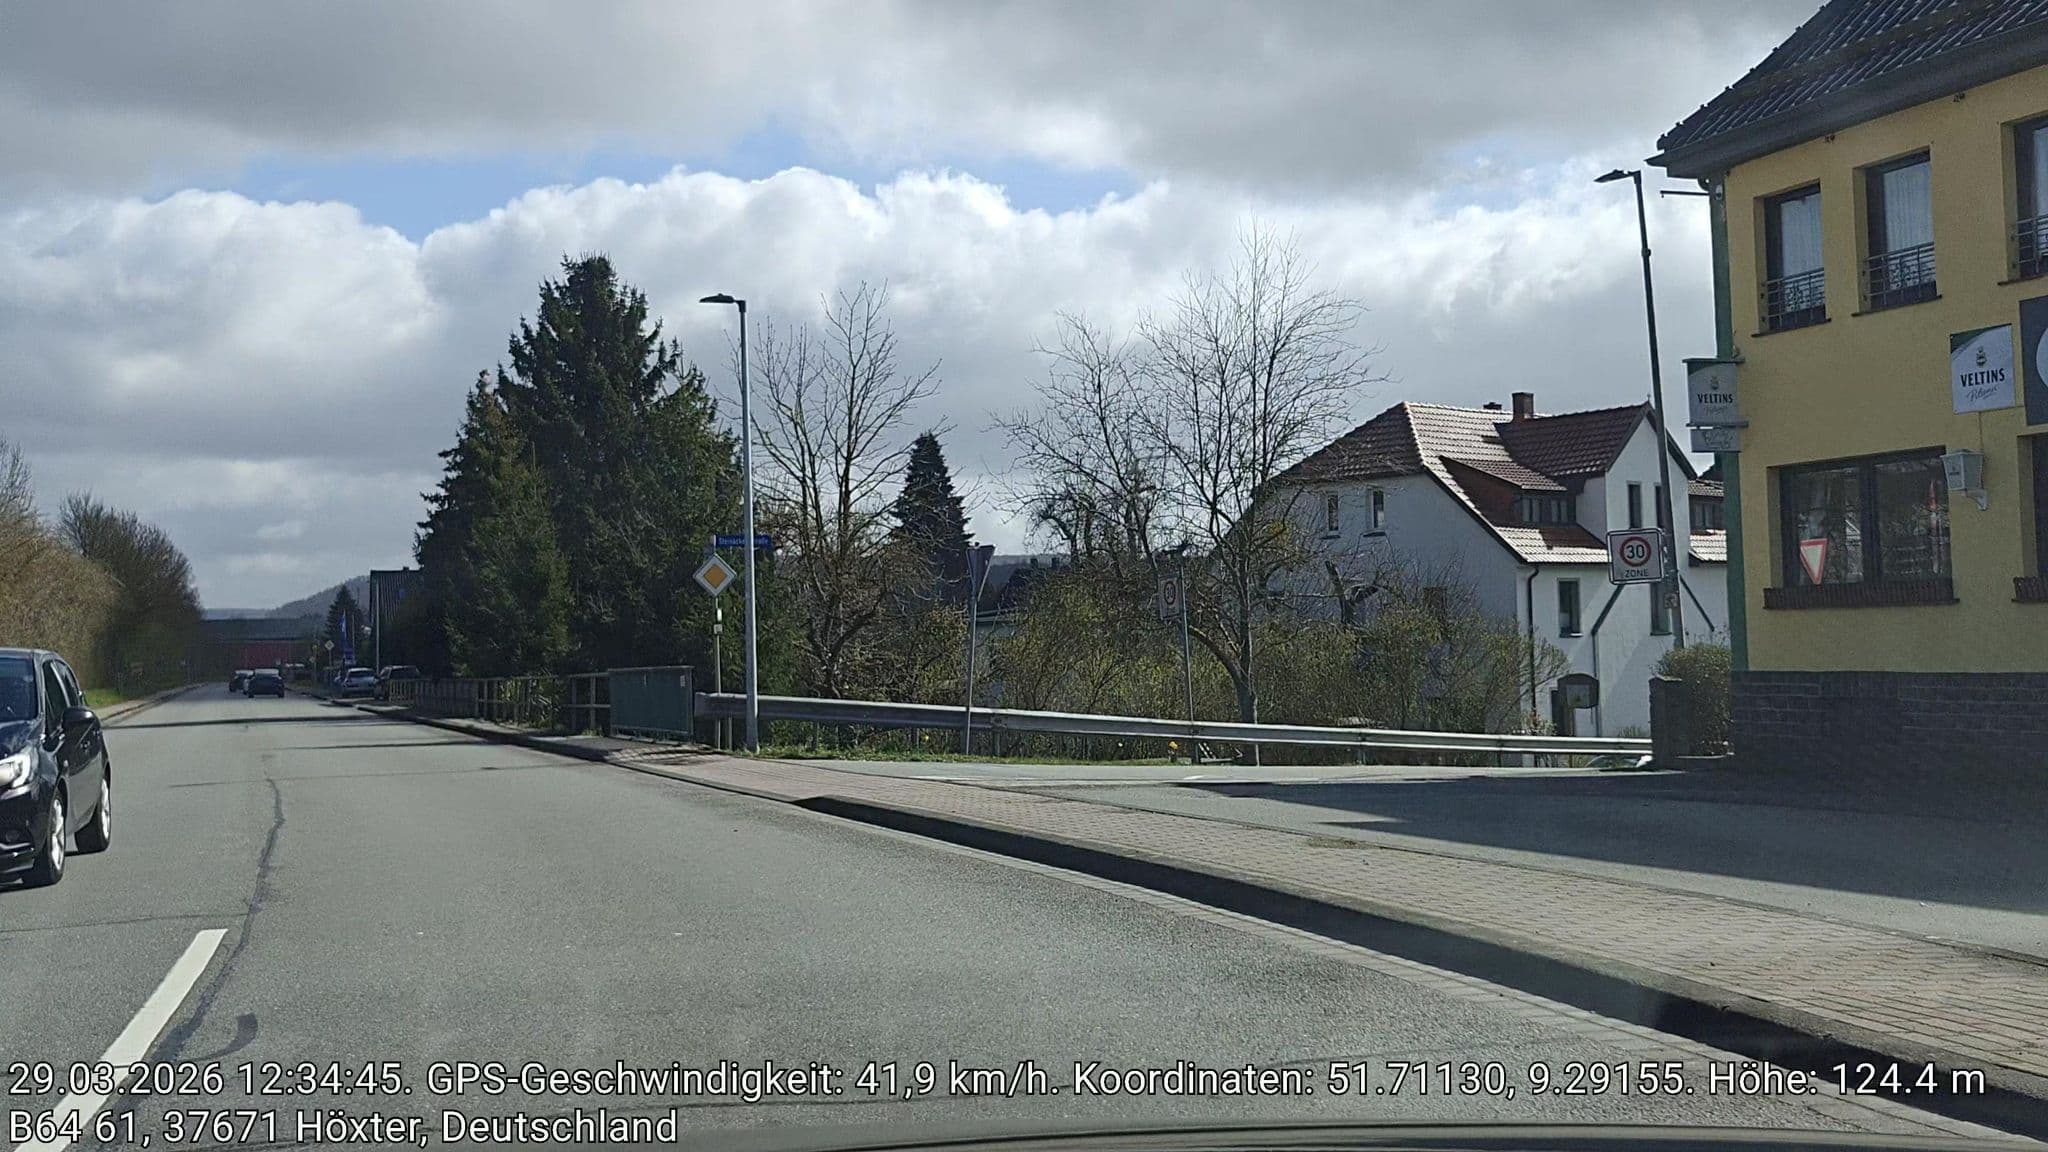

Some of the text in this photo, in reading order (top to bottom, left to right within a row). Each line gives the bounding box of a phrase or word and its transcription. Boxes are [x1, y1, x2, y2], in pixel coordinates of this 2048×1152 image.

[1960, 368, 2006, 387] VELTINS
[1697, 393, 1734, 404] VELTINS
[1626, 544, 1645, 559] 30
[1624, 568, 1649, 578] ZONE
